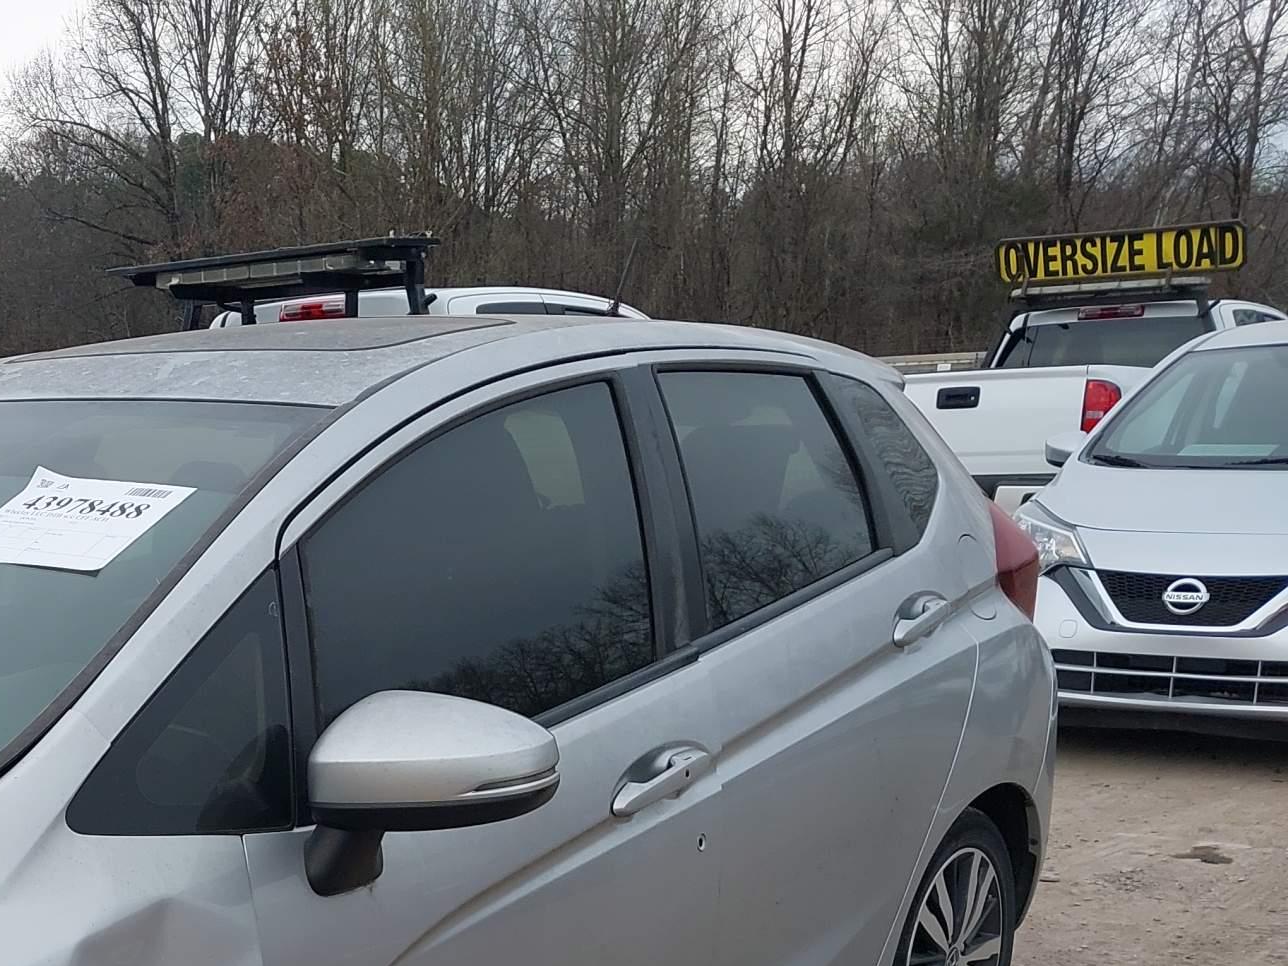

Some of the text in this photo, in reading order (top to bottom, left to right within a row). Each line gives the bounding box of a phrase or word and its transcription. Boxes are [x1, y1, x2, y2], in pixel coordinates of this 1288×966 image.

[1004, 224, 1240, 280] OVERSIZE LOAD
[23, 495, 151, 518] 43978488
